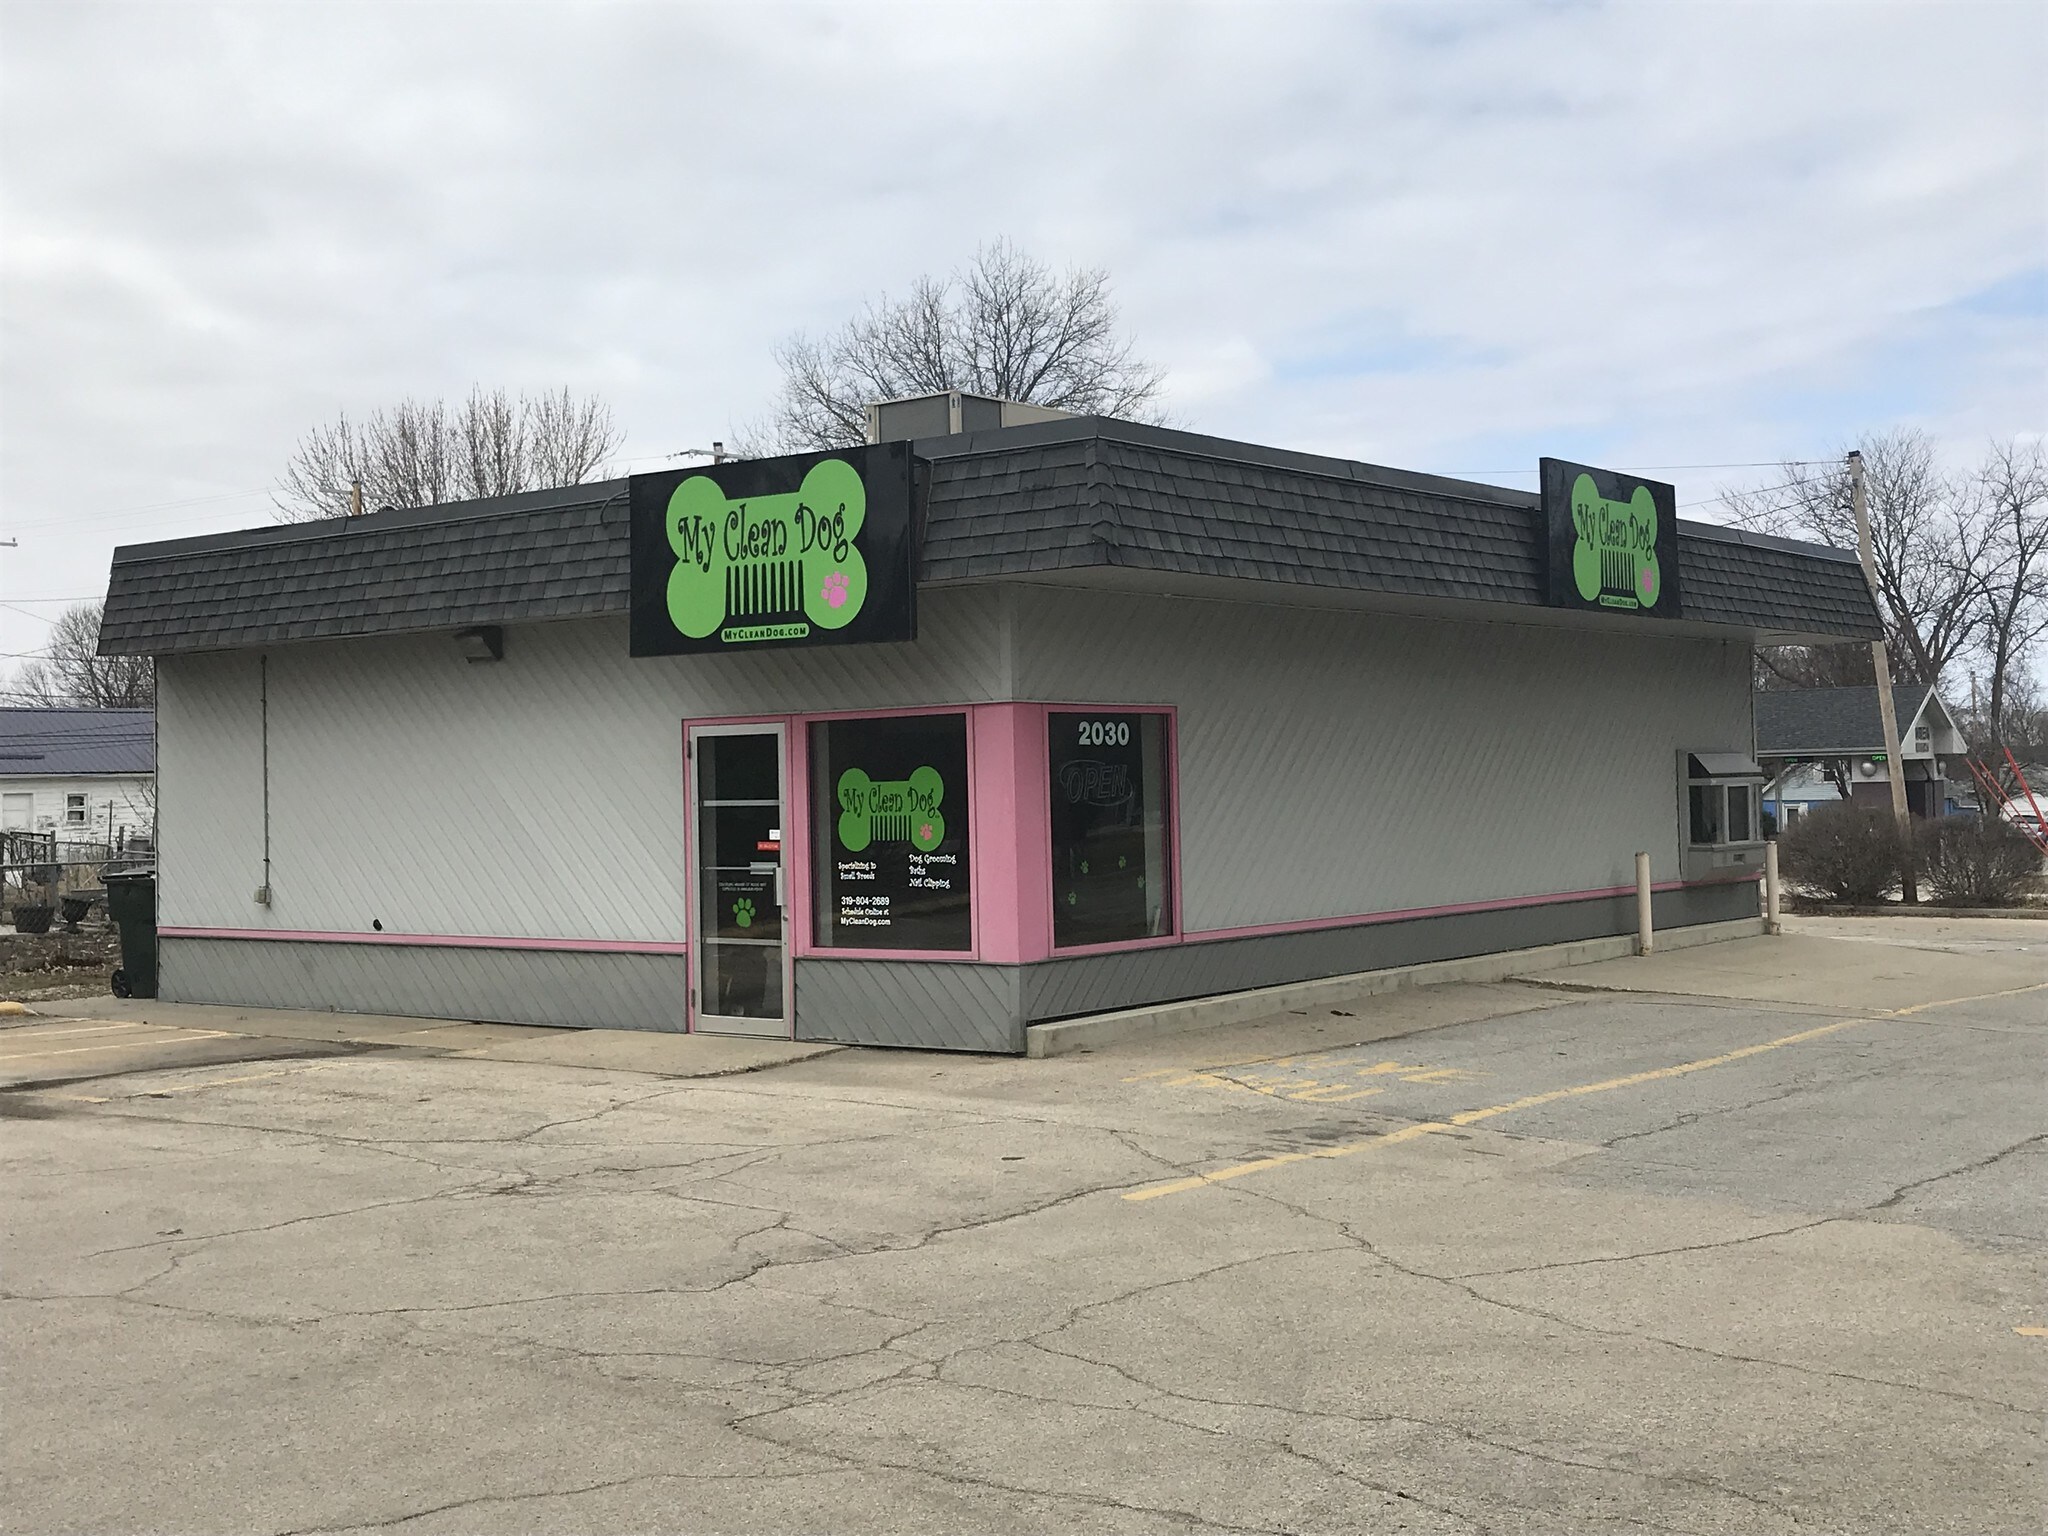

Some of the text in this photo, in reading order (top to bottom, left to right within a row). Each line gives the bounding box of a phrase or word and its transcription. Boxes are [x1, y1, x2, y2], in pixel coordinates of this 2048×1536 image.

[678, 502, 850, 573] My Clean Dog
[1577, 503, 1653, 561] My Clean Dog
[1078, 721, 1130, 746] 2030
[1067, 764, 1128, 804] OPEN
[843, 785, 935, 818] My Clean Dog
[908, 854, 957, 865] Dog Grooming
[840, 871, 856, 880] Small
[908, 878, 951, 889] Nail Clipping
